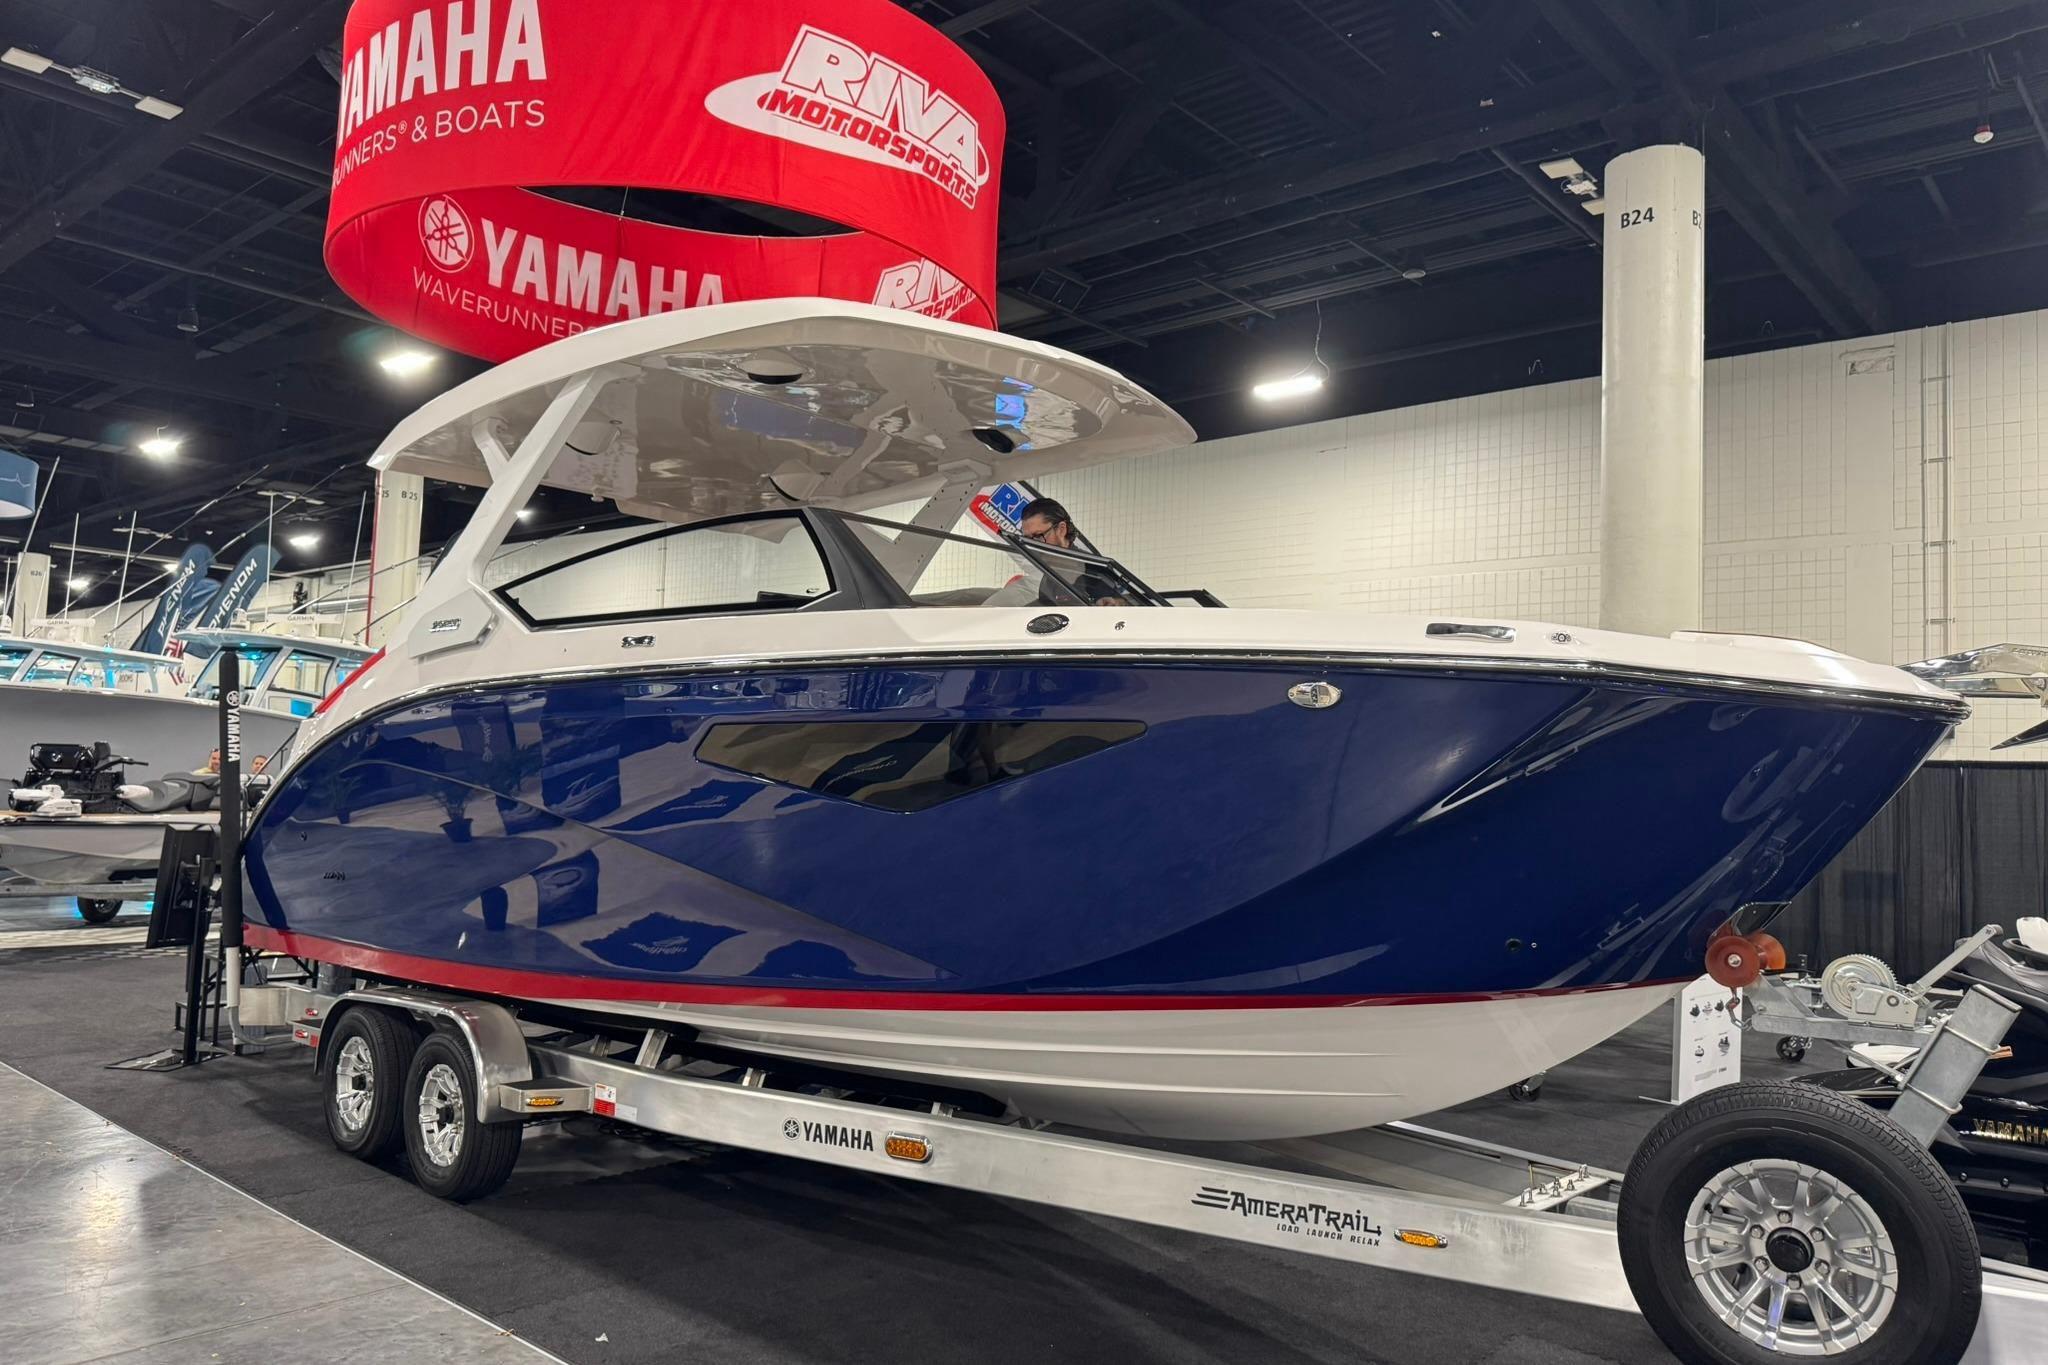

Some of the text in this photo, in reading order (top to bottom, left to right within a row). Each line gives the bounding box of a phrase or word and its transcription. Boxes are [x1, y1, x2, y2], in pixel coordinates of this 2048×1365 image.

[337, 0, 548, 149] YAMAHA
[781, 23, 978, 182] RIVA
[411, 115, 428, 143] &
[434, 99, 546, 138] BOATS
[765, 88, 978, 207] MOTORSPORTS
[1620, 206, 1655, 229] B24
[413, 266, 594, 338] WAVERUNNER
[481, 217, 725, 321] YAMAHA
[208, 558, 258, 635] PHENOM
[227, 705, 241, 762] YAMAHA
[803, 1120, 875, 1152] YAMAHA
[1276, 1222, 1381, 1247] LOAD LAUNCH RELAX
